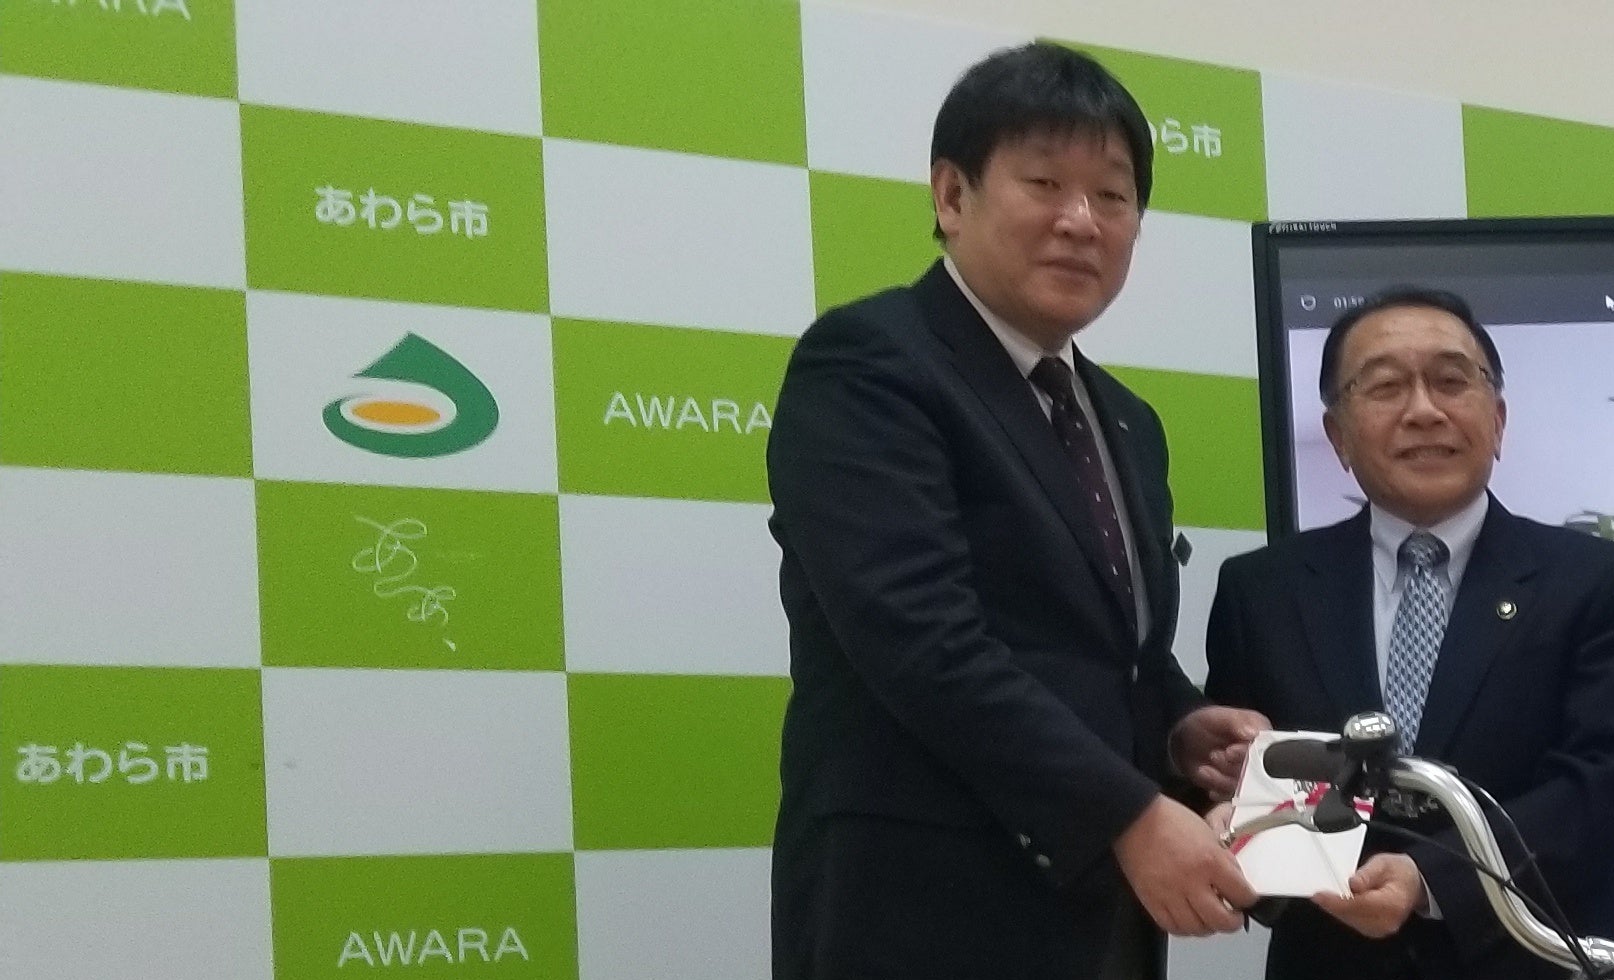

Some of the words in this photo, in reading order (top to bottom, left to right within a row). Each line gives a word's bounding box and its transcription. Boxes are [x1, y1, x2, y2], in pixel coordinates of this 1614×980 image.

[1149, 117, 1223, 158] ら市
[314, 184, 490, 239] あわら市
[604, 391, 773, 435] AWARA
[16, 742, 210, 786] あわら市
[338, 928, 530, 967] AWARA
